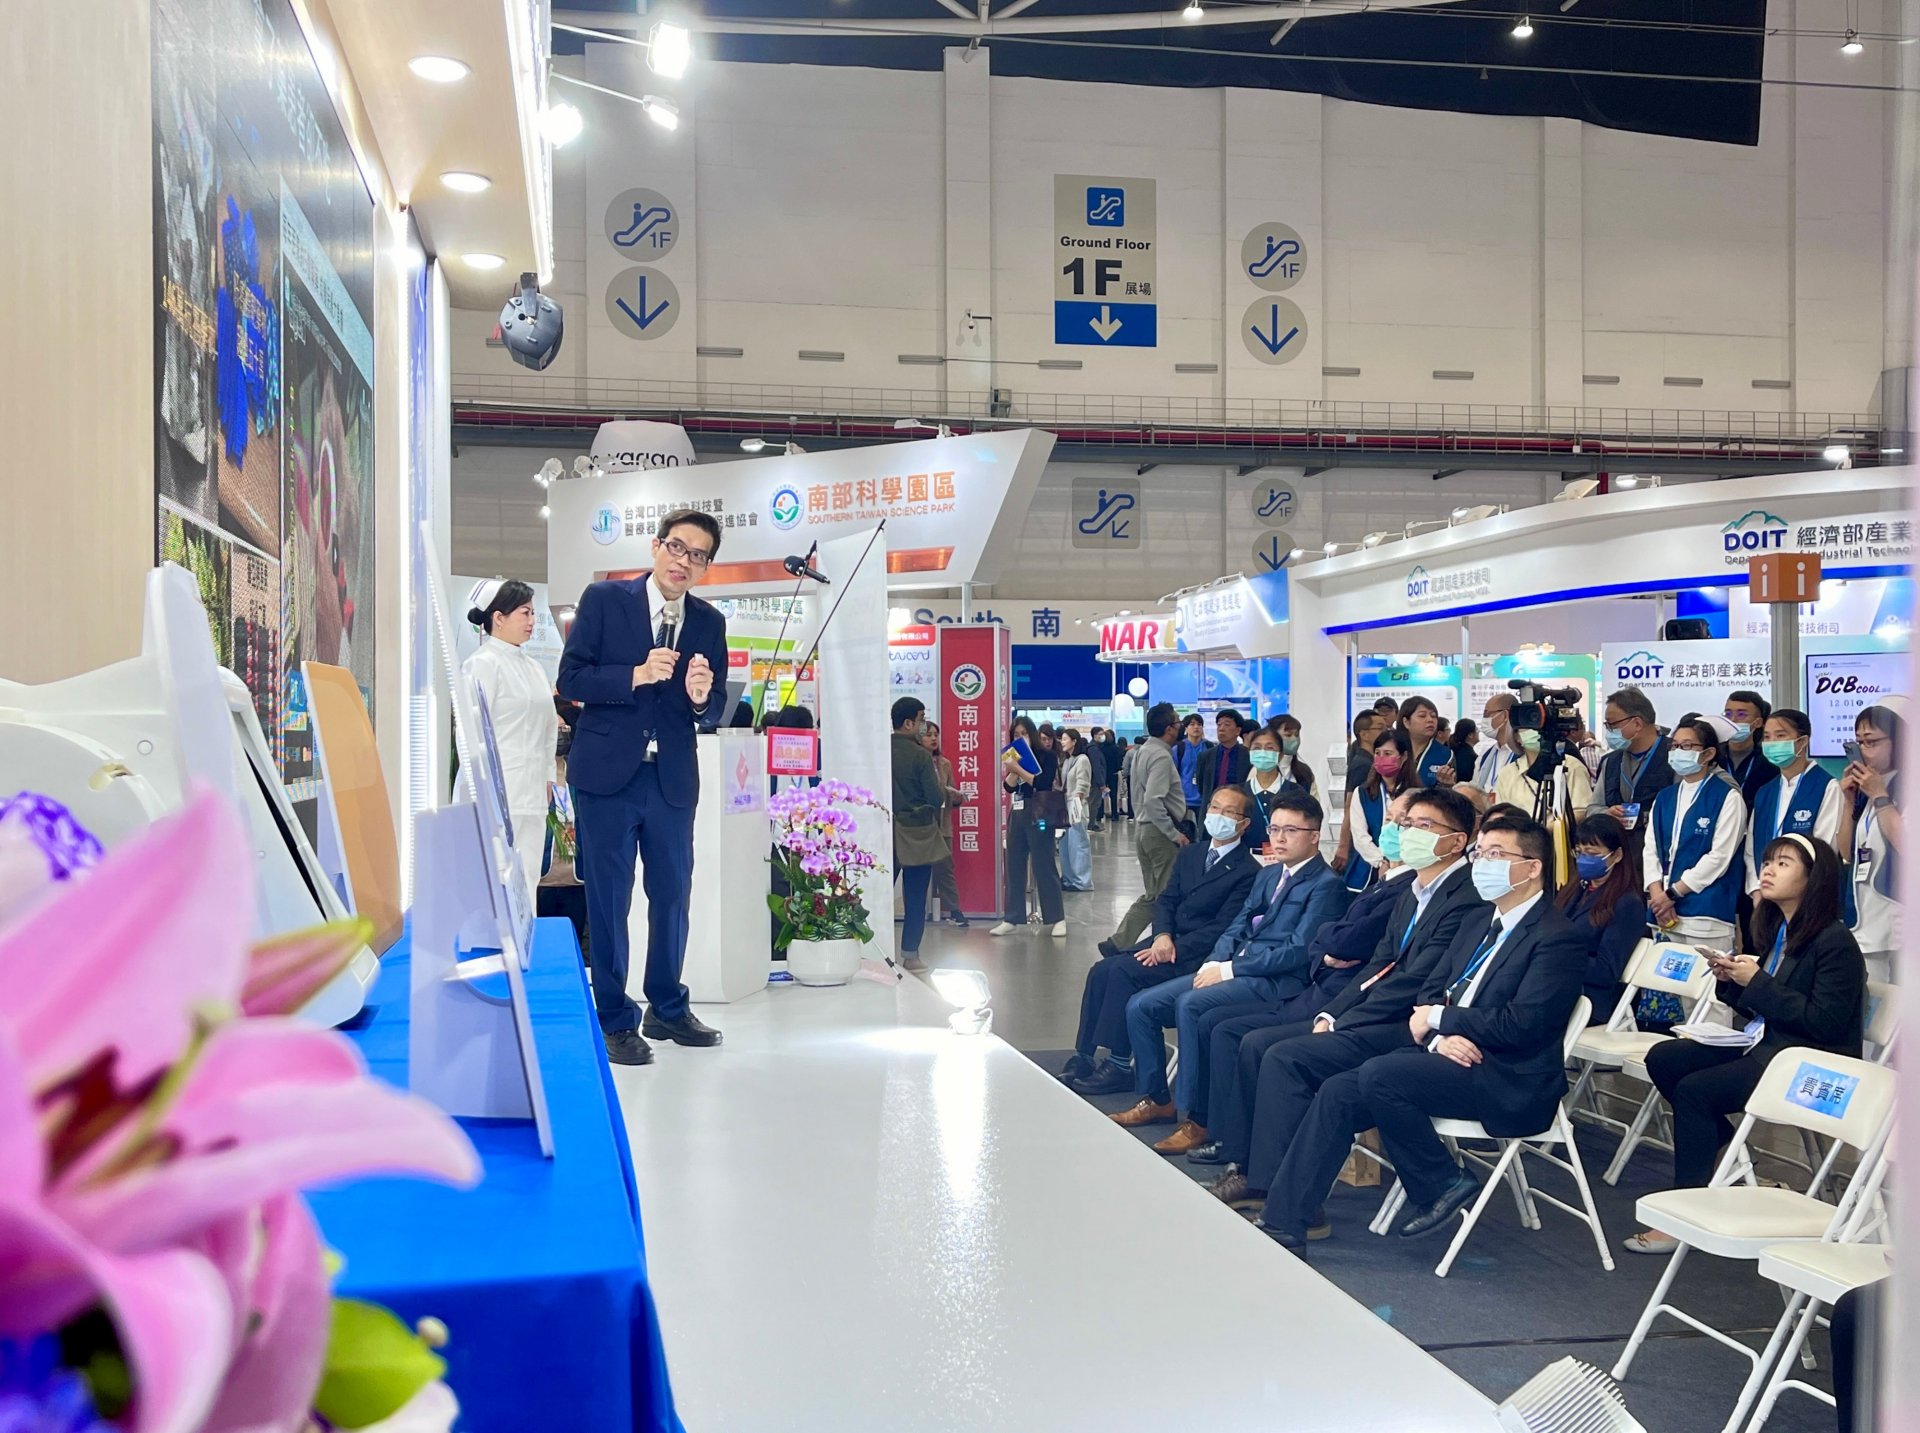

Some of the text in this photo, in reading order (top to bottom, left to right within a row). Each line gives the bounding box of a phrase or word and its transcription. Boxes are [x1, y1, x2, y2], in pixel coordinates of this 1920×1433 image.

[649, 231, 672, 249] 1F
[1060, 235, 1152, 250] Ground Floor
[1062, 257, 1152, 296] 1F 展場
[1280, 262, 1300, 279] 1F
[807, 471, 956, 512] 南部科學園區
[807, 502, 956, 525] SOUTHERN TAIWAN SCIENCE PARK
[1280, 506, 1292, 518] 1F
[1724, 528, 1788, 551] DOIT
[1808, 547, 1863, 560] dustrial
[1407, 580, 1429, 597] DOIT
[1032, 607, 1061, 638] 南
[1618, 665, 1664, 679] DOIT
[1617, 681, 1665, 689] Department
[1666, 679, 1675, 688] of
[1677, 679, 1715, 688] Industrial
[957, 704, 980, 853] 南部科學園區
